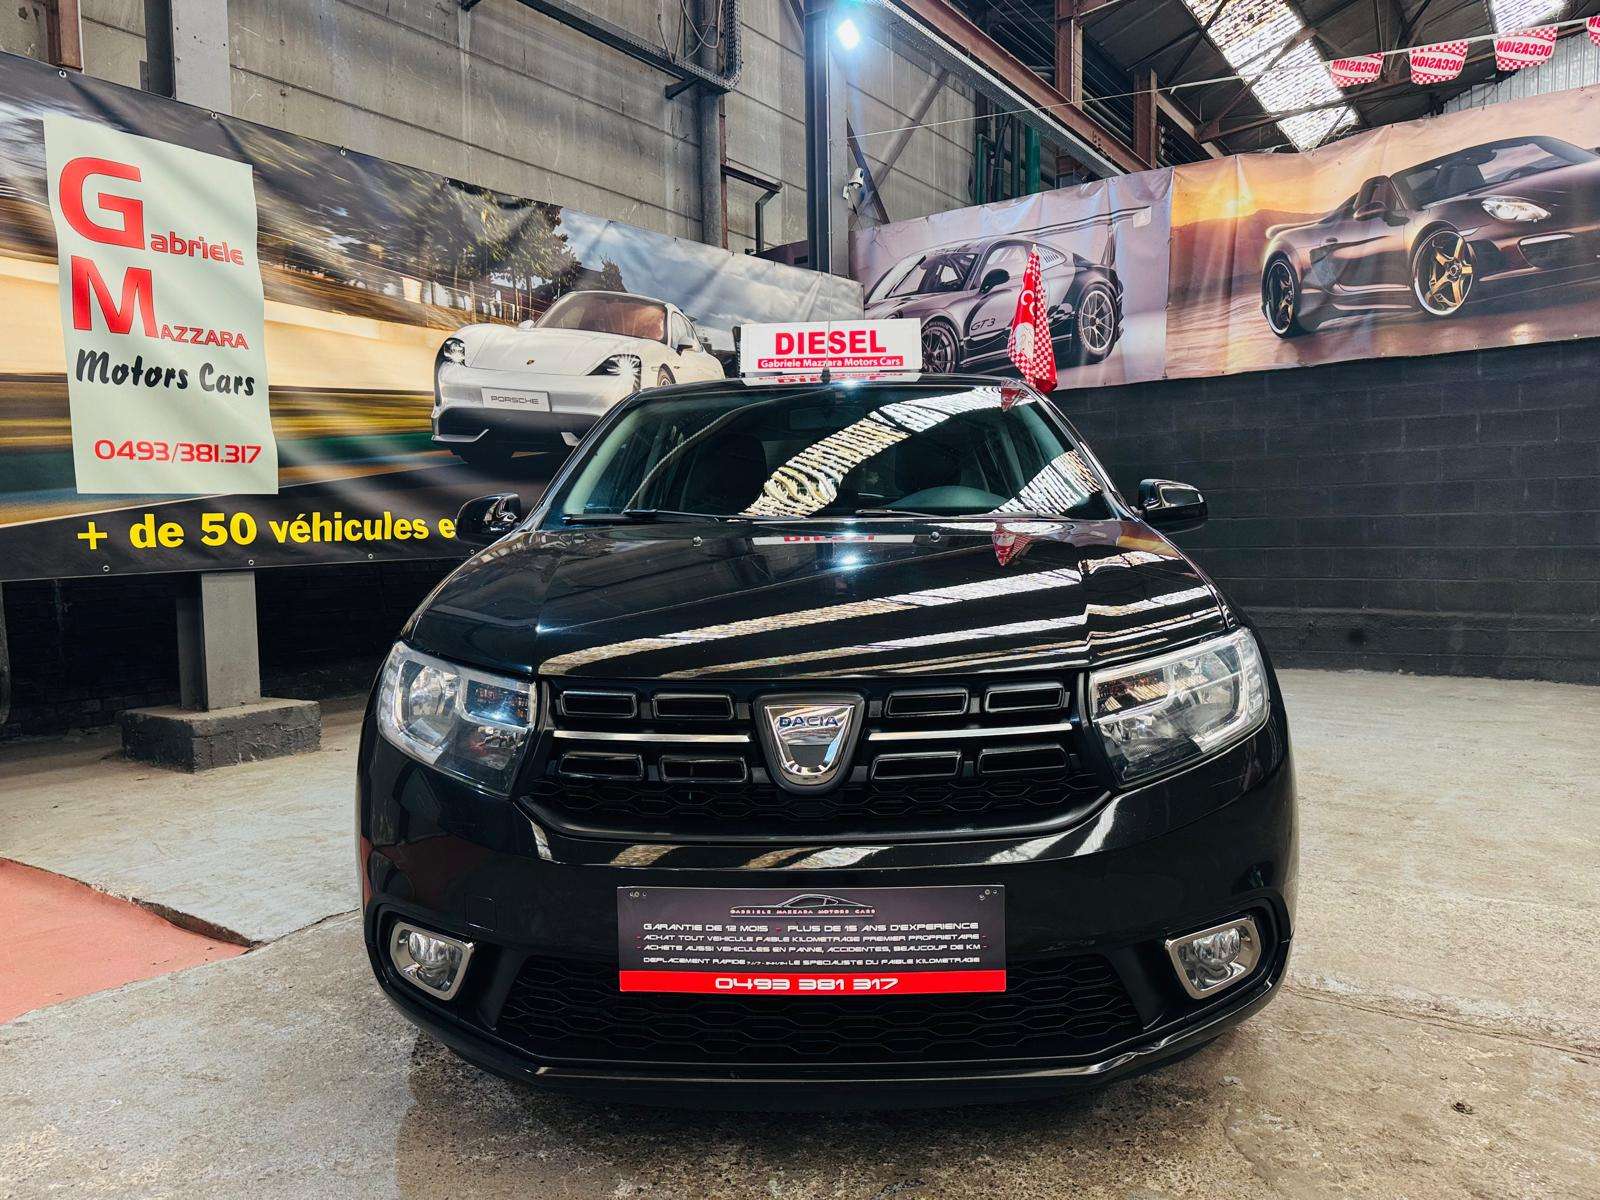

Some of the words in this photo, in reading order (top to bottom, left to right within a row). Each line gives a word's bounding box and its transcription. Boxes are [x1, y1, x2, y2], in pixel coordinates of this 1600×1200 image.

[970, 317, 996, 332] GT3
[775, 329, 887, 356] DIESEL
[761, 359, 802, 369] Gabriele
[803, 358, 843, 368] Mazzara
[844, 357, 878, 367] Motors
[879, 356, 901, 366] Cars
[76, 348, 189, 390] Motors
[199, 362, 256, 396] Cars
[490, 395, 541, 405] PORSCHE
[94, 438, 263, 465] 0493/381.317
[130, 513, 185, 549] de
[201, 511, 258, 547] 50
[270, 511, 430, 543] véhicules
[438, 518, 458, 539] e
[779, 716, 839, 727] DACIA
[643, 923, 703, 931] GARANTIE
[705, 924, 723, 932] DE
[890, 922, 979, 931] D'EXPERIENCE
[893, 944, 948, 952] BEAUCOUP
[715, 977, 790, 990] 0493
[798, 977, 845, 991] 381
[852, 977, 899, 991] 317
